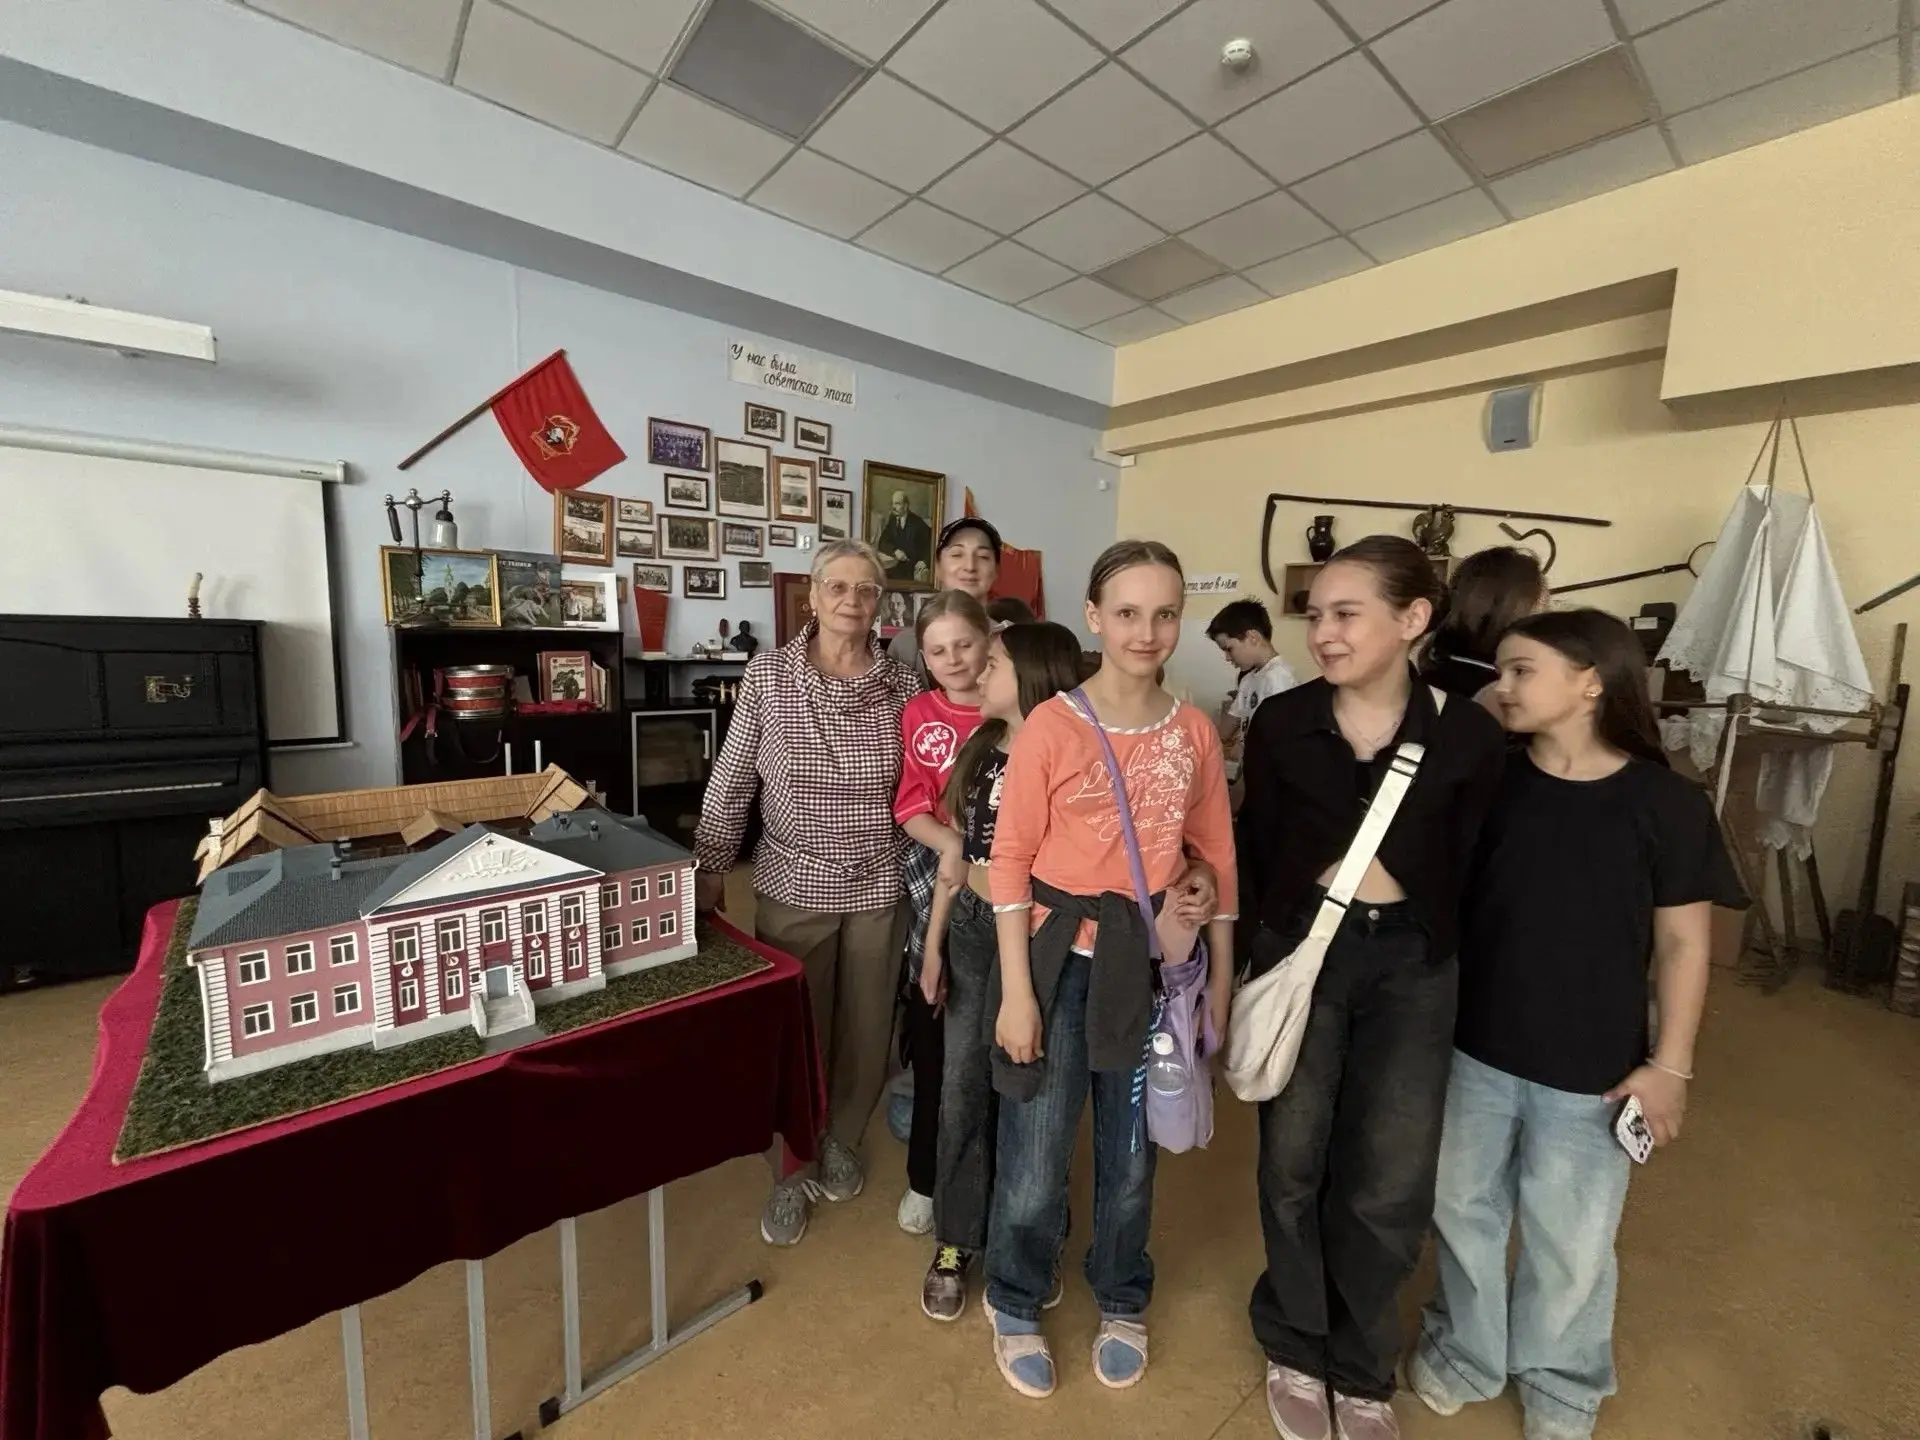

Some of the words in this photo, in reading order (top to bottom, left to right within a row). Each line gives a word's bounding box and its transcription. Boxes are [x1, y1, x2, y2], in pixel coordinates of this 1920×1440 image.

[731, 344, 743, 360] У
[747, 352, 766, 367] нас
[770, 354, 798, 375] была
[763, 372, 820, 396] советская
[824, 387, 854, 405] эпоха
